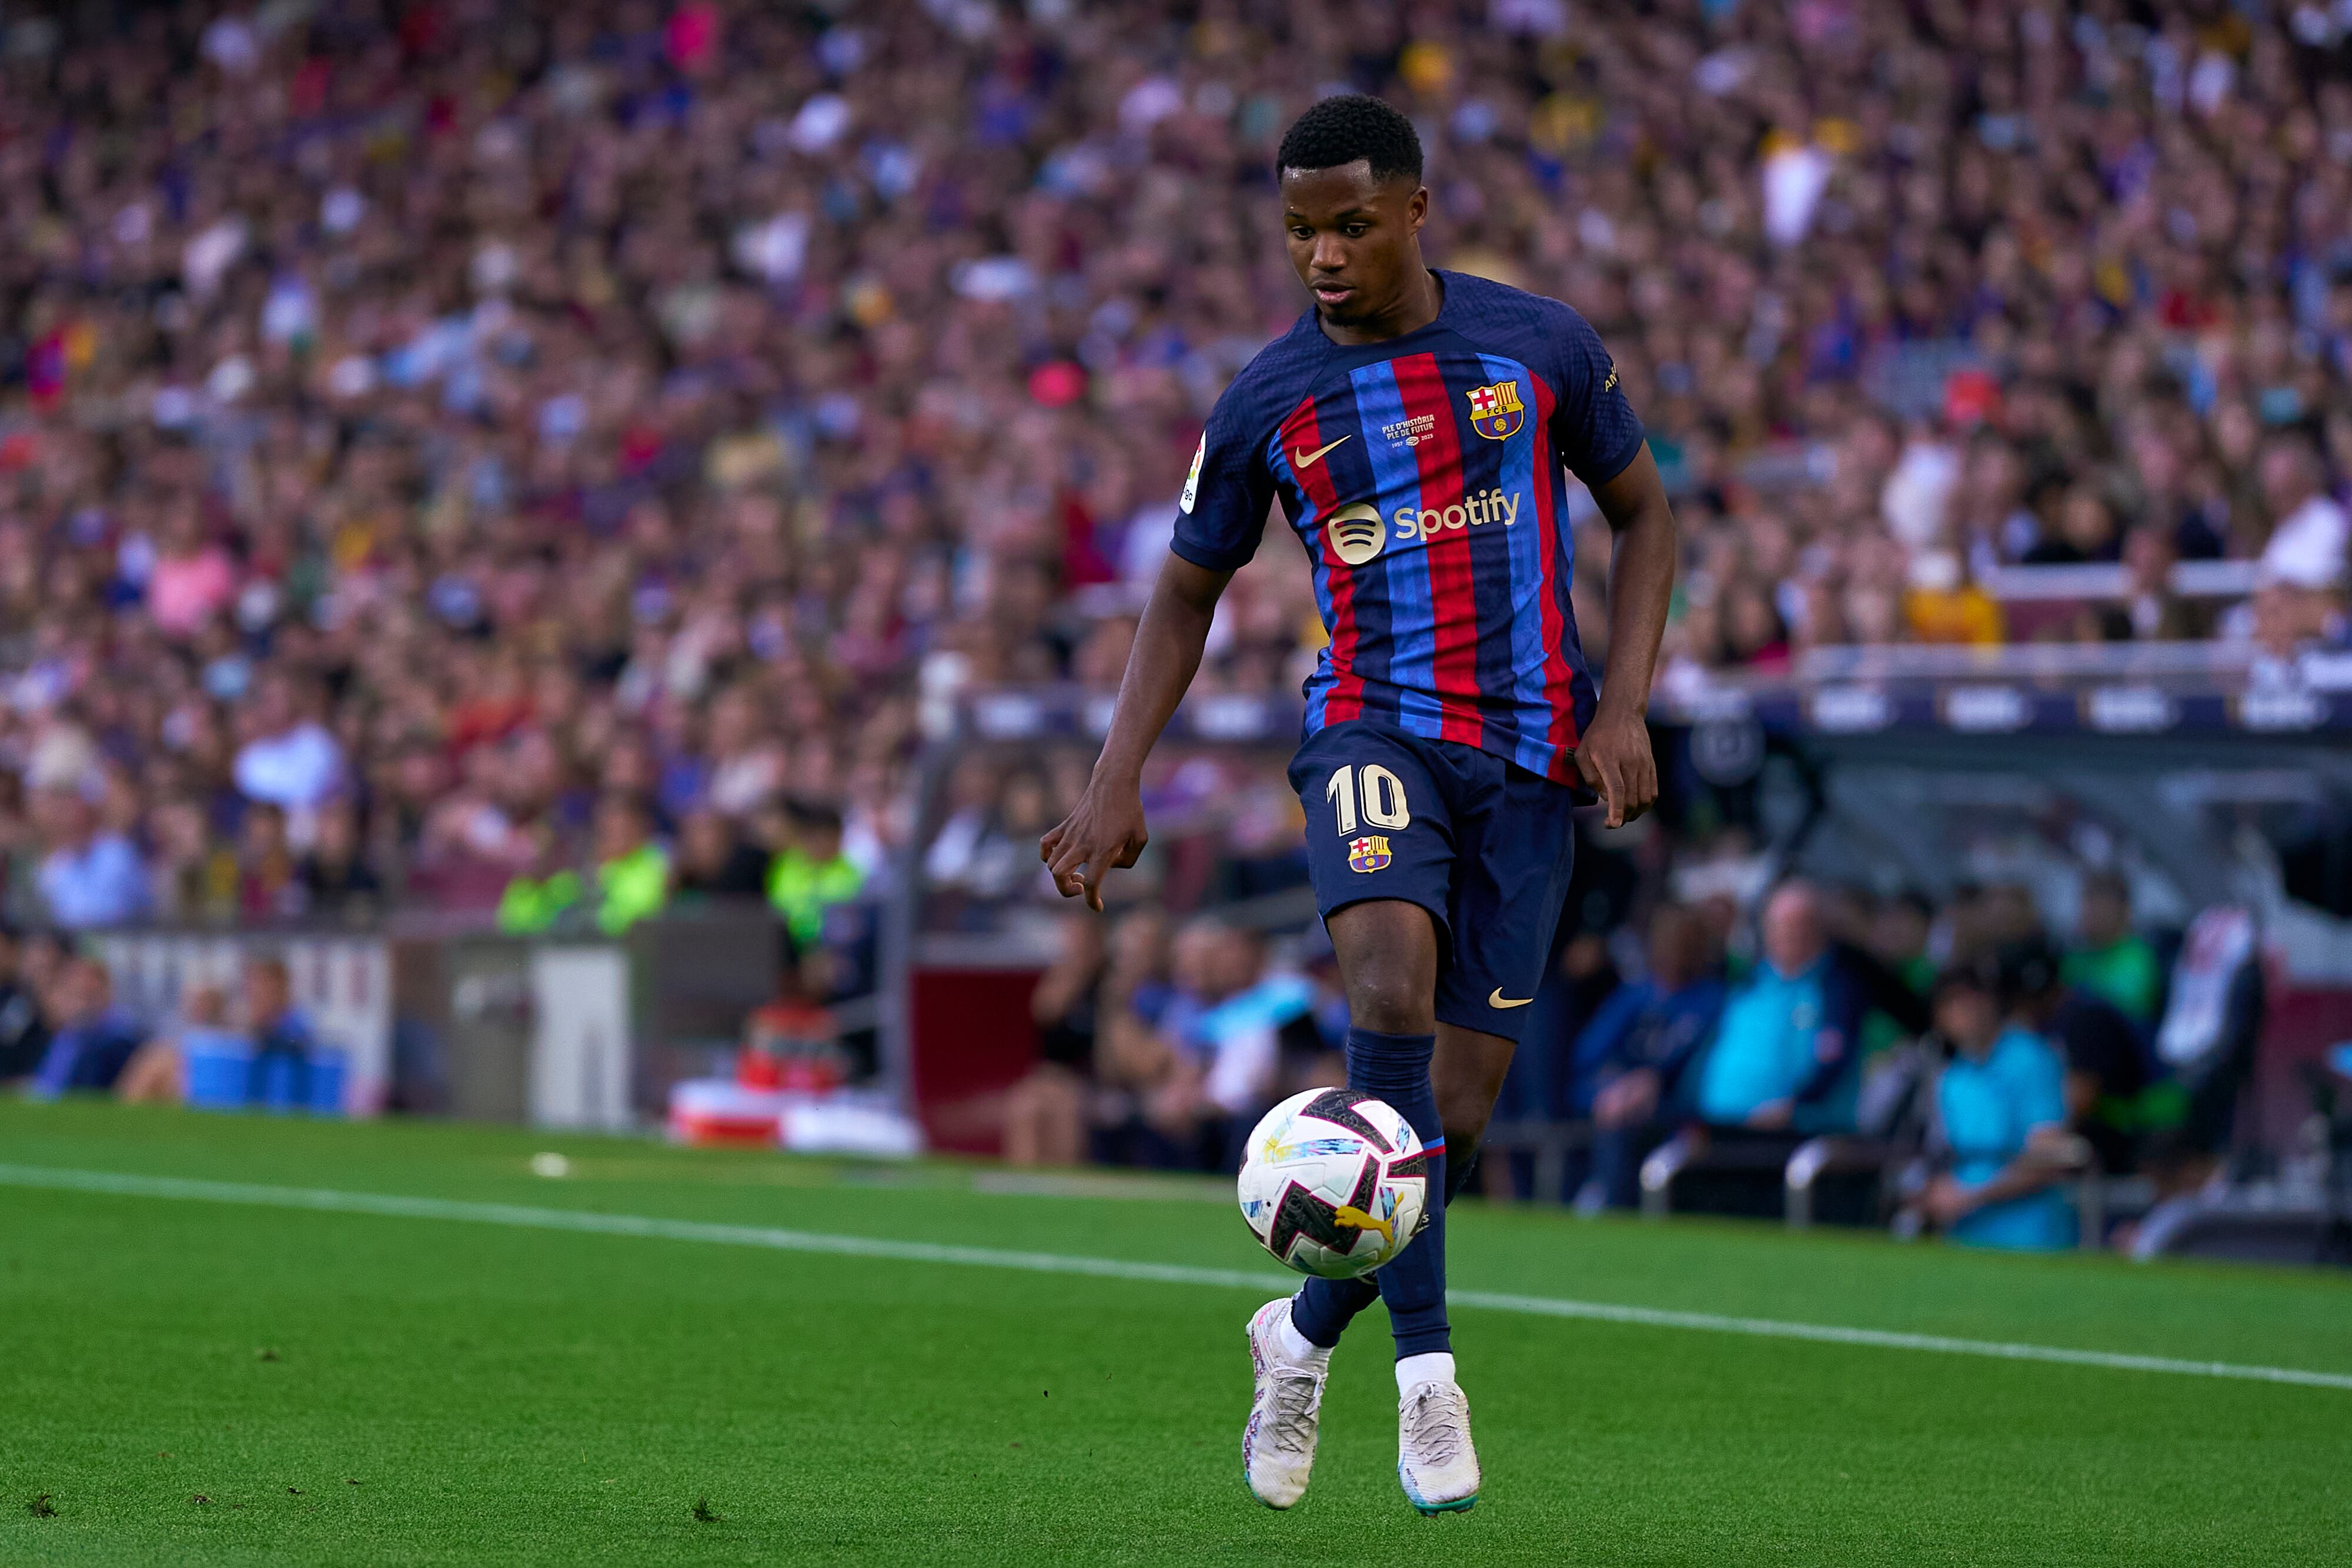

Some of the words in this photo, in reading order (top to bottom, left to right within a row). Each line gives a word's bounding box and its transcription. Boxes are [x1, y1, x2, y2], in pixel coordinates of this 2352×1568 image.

[1382, 424, 1395, 434] PLE
[1395, 414, 1435, 430] D'HISTÒRIA
[1387, 430, 1399, 440] PLE
[1400, 428, 1410, 437] DE
[1411, 422, 1434, 434] FUTUR
[1394, 488, 1520, 541] Spotify
[1326, 764, 1411, 837] 10
